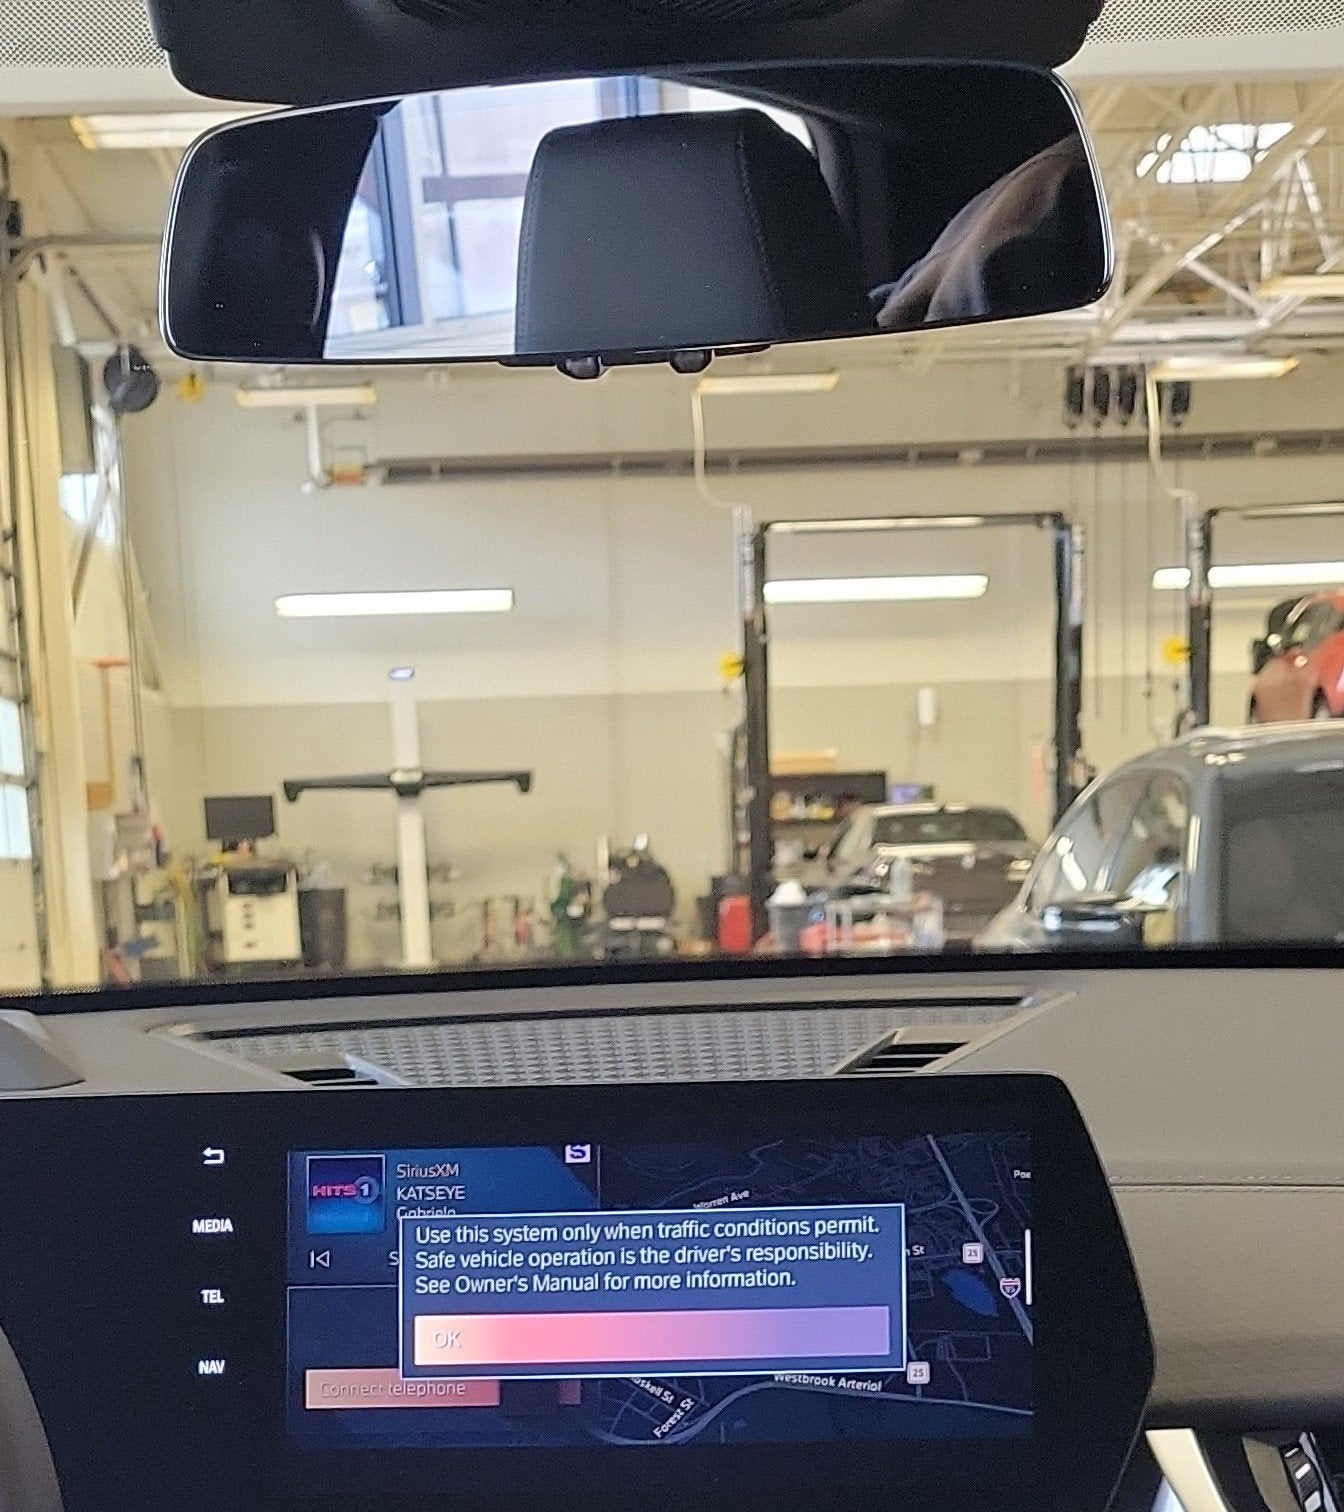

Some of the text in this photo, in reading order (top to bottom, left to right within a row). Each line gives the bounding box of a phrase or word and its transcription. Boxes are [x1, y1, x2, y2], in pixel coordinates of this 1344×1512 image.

[395, 1163, 460, 1178] SiriusXM
[312, 1184, 357, 1197] HITS
[395, 1186, 467, 1201] KATSEYE
[192, 1218, 234, 1234] MEDIA
[415, 1215, 880, 1246] Use this system only when traffic conditions permit.
[415, 1250, 456, 1269] Safe
[459, 1250, 524, 1269] vehicle
[527, 1248, 616, 1270] operation
[620, 1248, 636, 1265] is
[640, 1245, 670, 1264] the
[674, 1244, 742, 1263] driver's
[745, 1241, 874, 1265] responsibility.
[415, 1268, 797, 1294] See Owner's Manual for more information.
[200, 1289, 225, 1304] TEL
[433, 1330, 462, 1349] OK
[198, 1359, 226, 1375] NAV
[320, 1380, 467, 1398] Connect telephone
